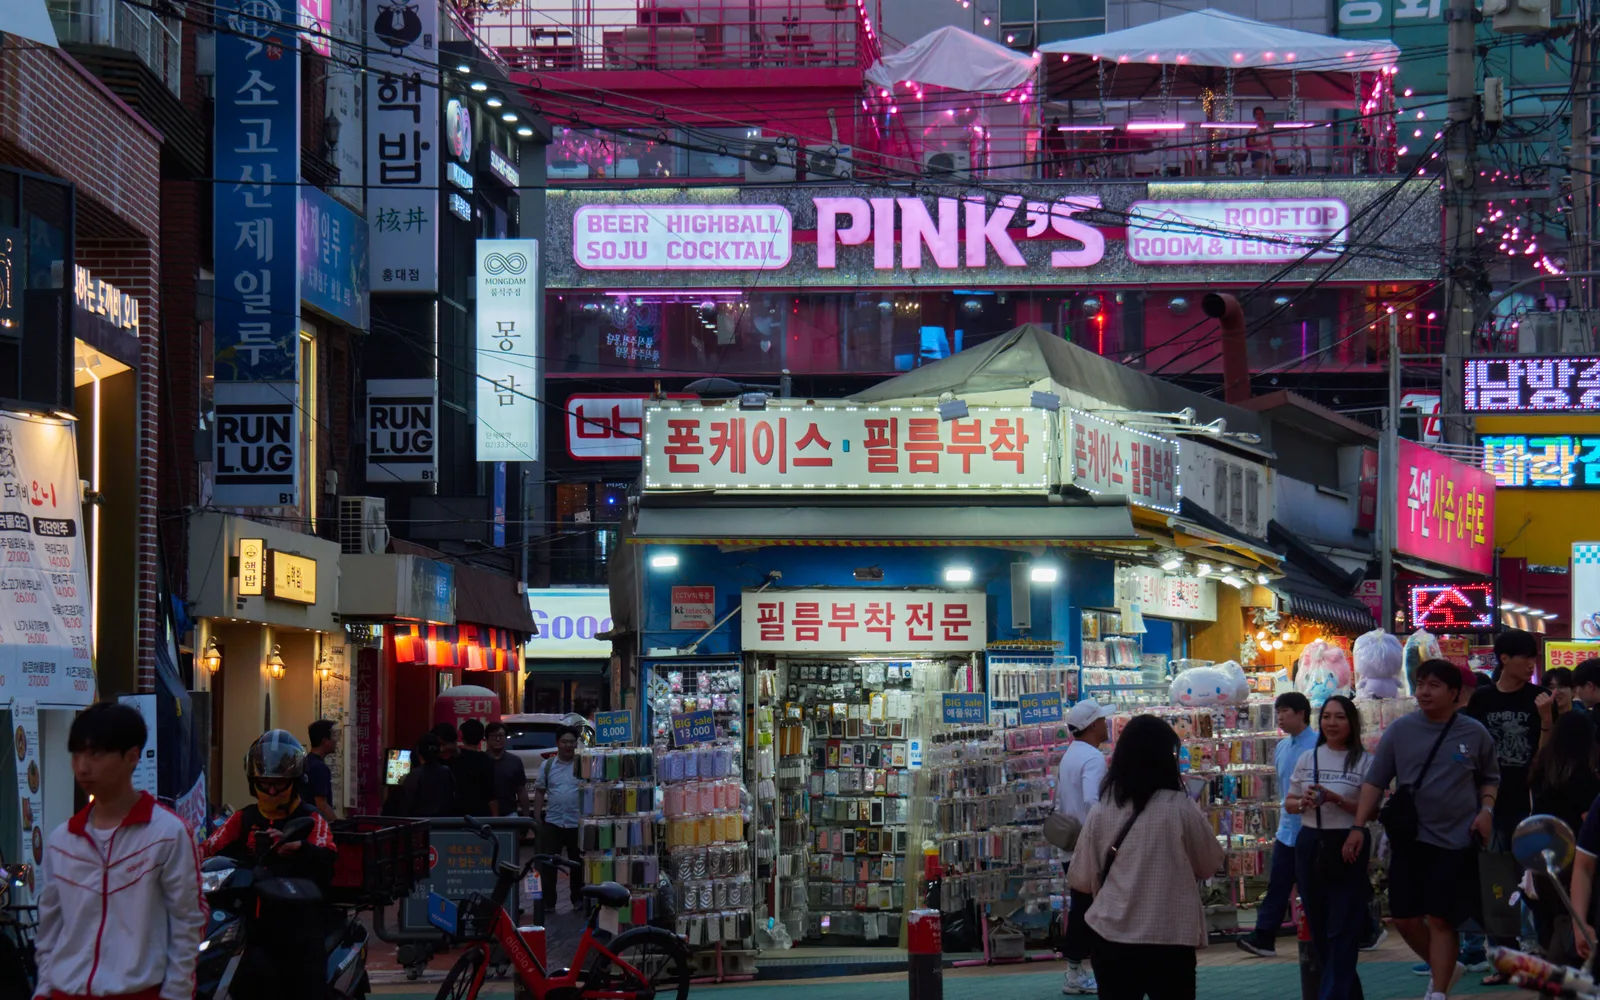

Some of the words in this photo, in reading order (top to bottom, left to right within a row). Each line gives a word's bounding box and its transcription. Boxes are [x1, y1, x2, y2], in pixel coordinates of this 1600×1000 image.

[376, 72, 432, 185] 핵밥
[233, 69, 279, 366] 소고산제일루
[374, 206, 428, 234] 核丼
[587, 215, 649, 233] BEER
[667, 214, 782, 233] HIGHBALL
[1224, 206, 1339, 227] ROOFTOP
[812, 194, 1106, 270] PINK'S
[587, 241, 648, 260] SOJU
[667, 241, 781, 260] COCKTAIL
[1133, 237, 1203, 257] ROOM
[1207, 237, 1224, 255] &
[382, 268, 419, 281] 홍대점
[485, 278, 526, 286] MONGDAM
[123, 294, 139, 337] 오니
[491, 320, 522, 407] 몽담
[370, 407, 433, 429] RUN
[217, 416, 291, 443] RUN
[370, 430, 433, 453] L.U.G
[217, 444, 293, 473] L.U.G
[422, 470, 434, 480] B1
[279, 493, 293, 504] B1
[1407, 466, 1431, 538] 주연
[38, 520, 69, 536] 간단안주
[674, 606, 684, 614] kt
[452, 700, 492, 714] 홍대
[965, 698, 982, 707] sale
[1022, 700, 1038, 709] BIG
[1041, 698, 1059, 707] sale
[597, 715, 612, 725] BIG
[614, 714, 629, 724] sale
[675, 718, 691, 729] BIG
[694, 716, 712, 726] sale
[602, 726, 625, 738] 8,000
[679, 726, 711, 740] 13,000
